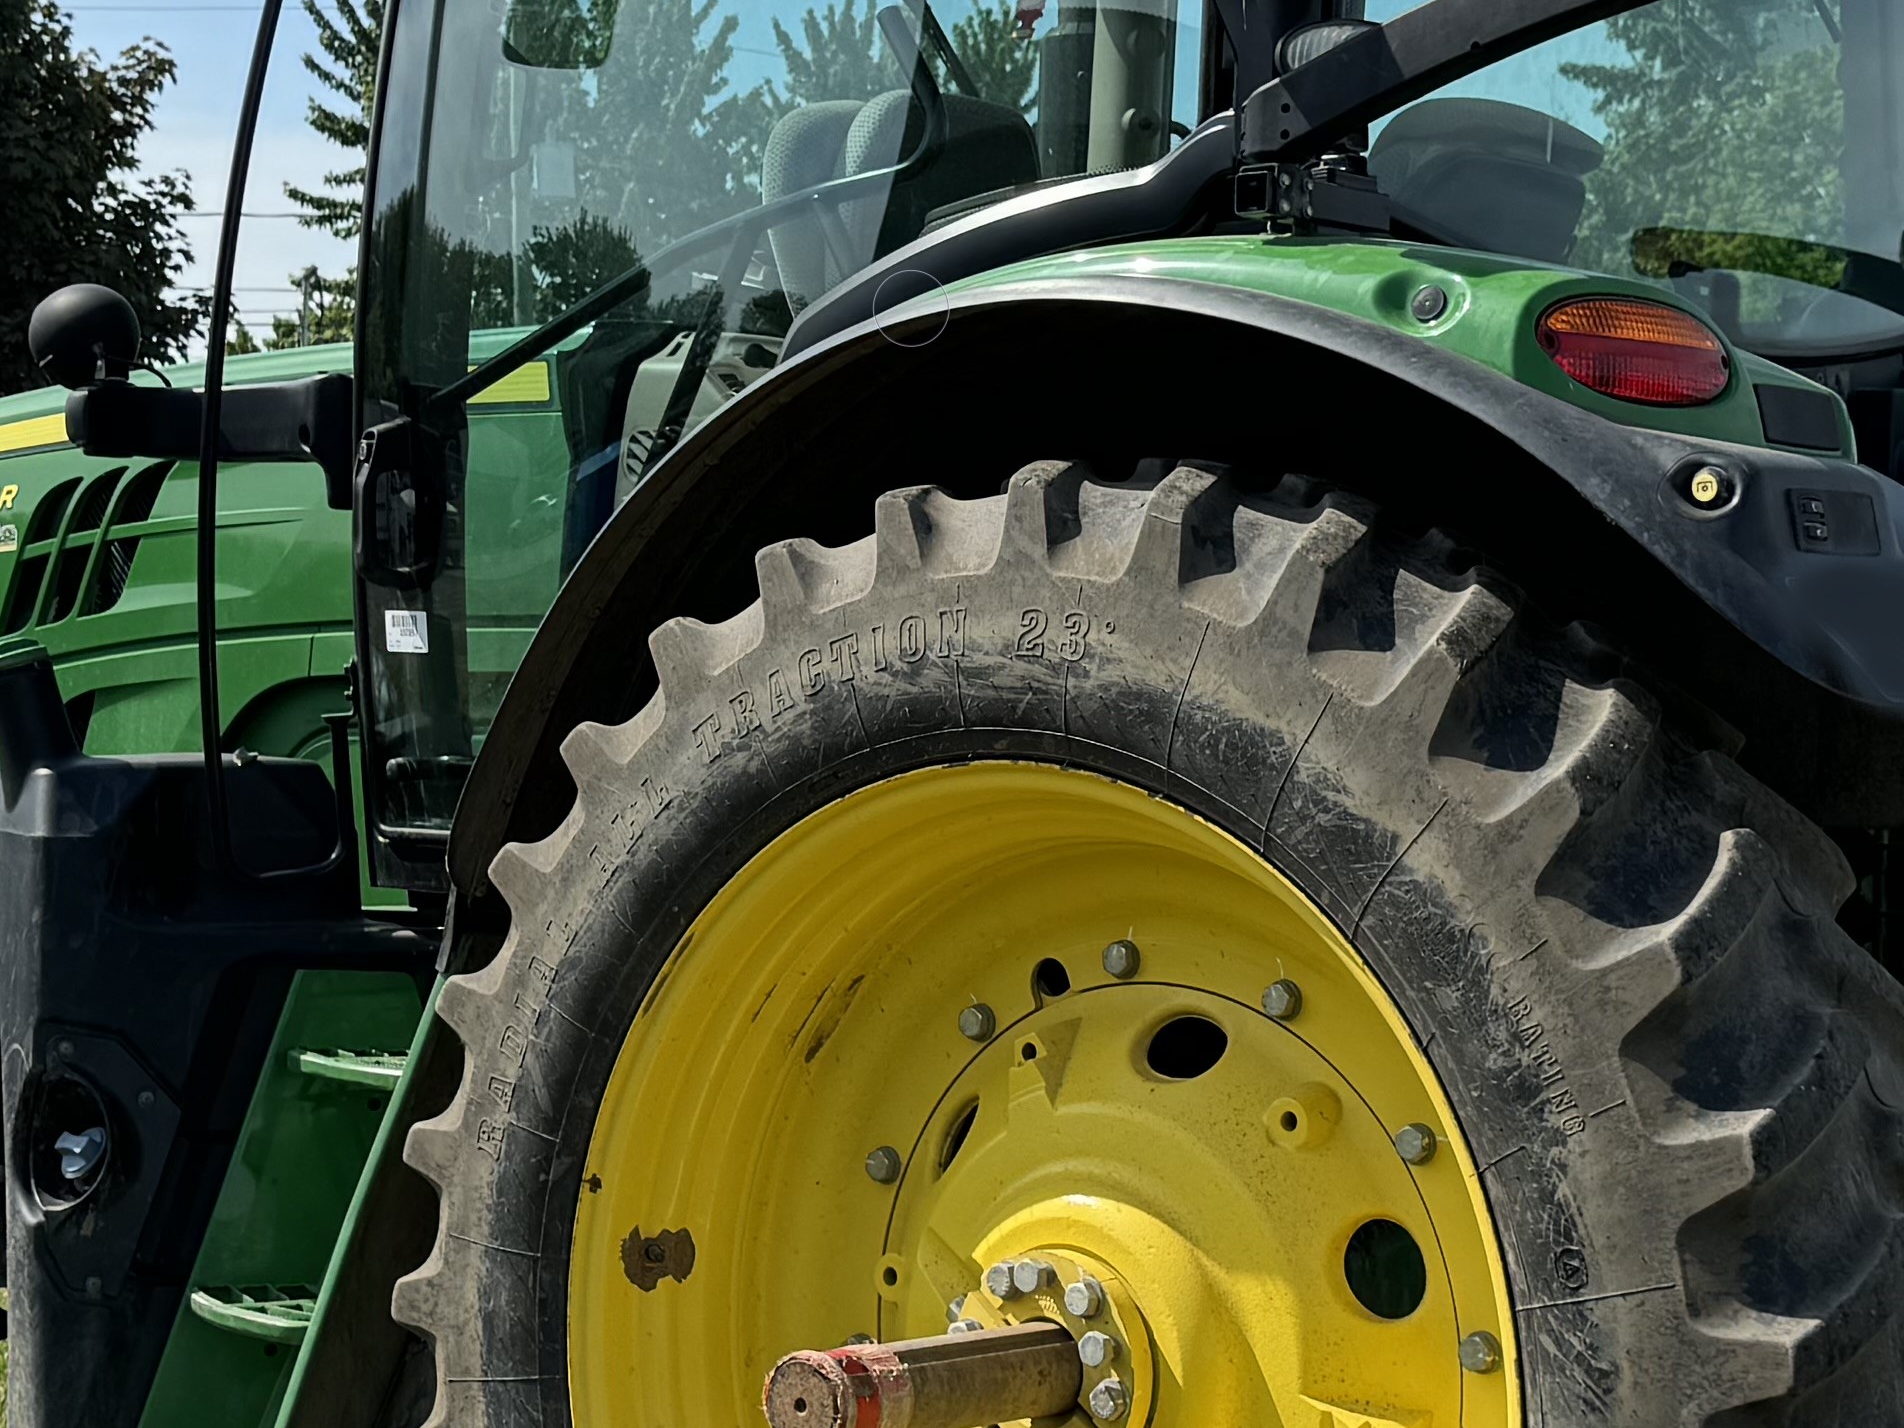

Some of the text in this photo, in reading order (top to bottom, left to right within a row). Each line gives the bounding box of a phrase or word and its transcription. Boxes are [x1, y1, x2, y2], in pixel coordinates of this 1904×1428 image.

[478, 918, 579, 1161] RADIAL
[692, 606, 967, 760] TRACTION
[1507, 995, 1587, 1136] RATING
